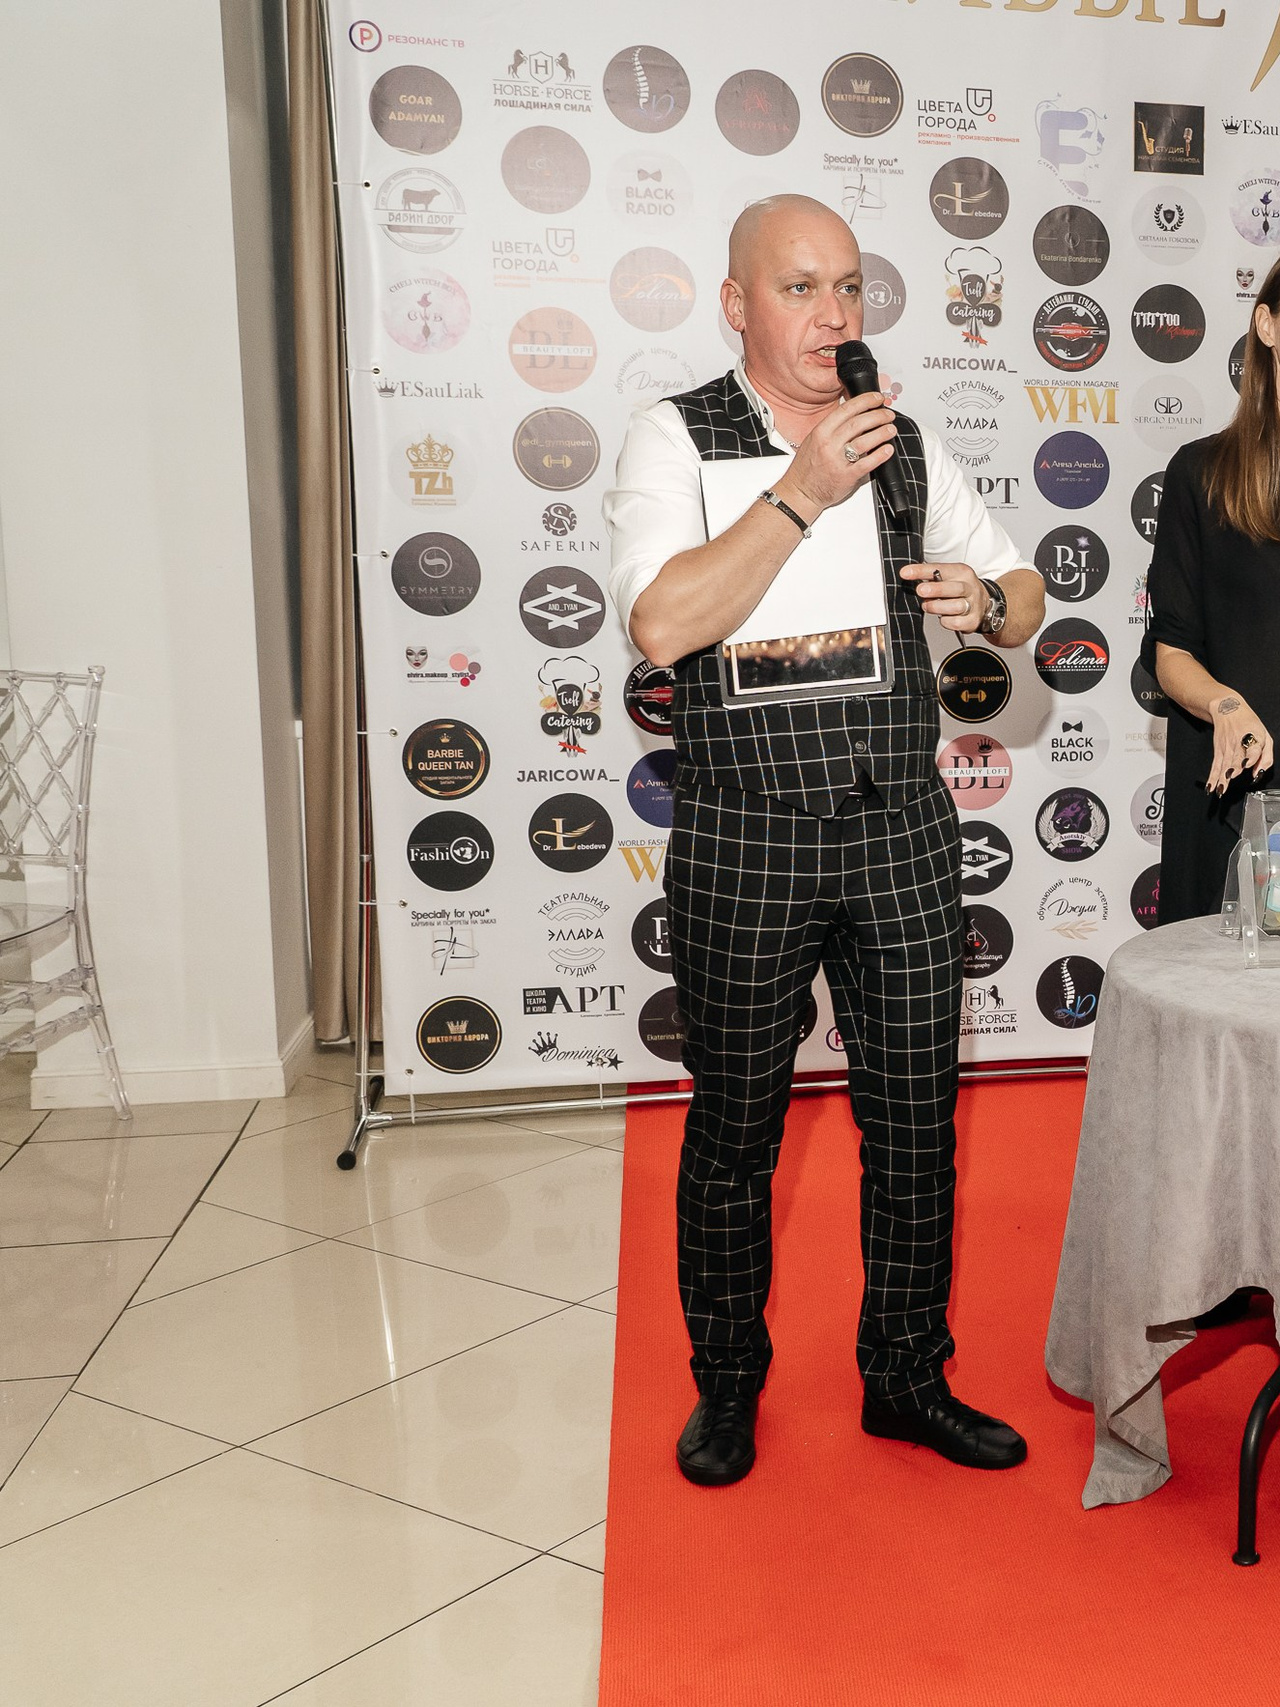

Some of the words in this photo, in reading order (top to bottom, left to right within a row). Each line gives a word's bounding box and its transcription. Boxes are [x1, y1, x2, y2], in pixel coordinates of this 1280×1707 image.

[388, 34, 448, 47] РЕЗОНАНС
[450, 38, 465, 48] ТВ
[399, 95, 433, 106] GOAR
[493, 98, 562, 111] ЛОШАДИНАЯ
[564, 102, 592, 113] СИЛА
[917, 100, 963, 114] ЦВЕТА
[389, 111, 445, 124] ADAMYAN
[917, 116, 977, 132] ГОРОДА
[823, 153, 862, 168] Specially
[864, 155, 875, 166] for
[1258, 177, 1280, 187] WITCH
[625, 187, 675, 201] BLACK
[625, 202, 675, 216] RADIO
[1139, 235, 1167, 243] СВЕТЛАНА
[1169, 236, 1200, 245] ГОБОЗОВА
[493, 241, 543, 256] ЦВЕТА
[493, 258, 559, 273] ГОРОДА
[1041, 253, 1066, 264] Ekaterina
[1068, 255, 1102, 264] Bondarenko
[952, 305, 995, 320] Catering
[523, 345, 563, 354] BEAUTY
[566, 347, 592, 355] LOFT
[401, 381, 484, 400] ESauLiak
[1024, 379, 1050, 387] WORLD
[1051, 380, 1081, 388] FASHION
[938, 381, 1005, 404] ТЕАТРАЛЬНАЯ
[1023, 386, 1120, 424] WFM
[1134, 416, 1166, 425] SERGIO
[1168, 417, 1202, 426] DALLINI
[952, 454, 991, 468] СТУДИЯ
[521, 540, 600, 553] SAFERIN
[547, 716, 594, 731] Catering
[1051, 737, 1093, 749] BLACK
[427, 749, 464, 759] BARBIE
[1051, 751, 1094, 762] RADIO
[418, 761, 453, 771] QUEEN
[455, 761, 474, 770] TAN
[538, 892, 611, 917] ТЕАТРАЛЬНАЯ
[1035, 879, 1064, 921] обучающий
[1069, 876, 1093, 887] центр
[1094, 886, 1108, 921] эстетики
[411, 909, 451, 921] Specially
[454, 909, 467, 919] for
[555, 963, 597, 977] СТУДИЯ
[525, 989, 546, 997] ШКОЛА
[551, 985, 626, 1014] АРТ
[532, 1005, 547, 1013] КИНО
[992, 1026, 1017, 1034] СИЛА
[427, 1035, 462, 1044] ВИКТОРИЯ
[464, 1033, 489, 1042] АВРОРА
[647, 1033, 674, 1042] Ekaterina
[542, 1046, 616, 1063] Dominica
